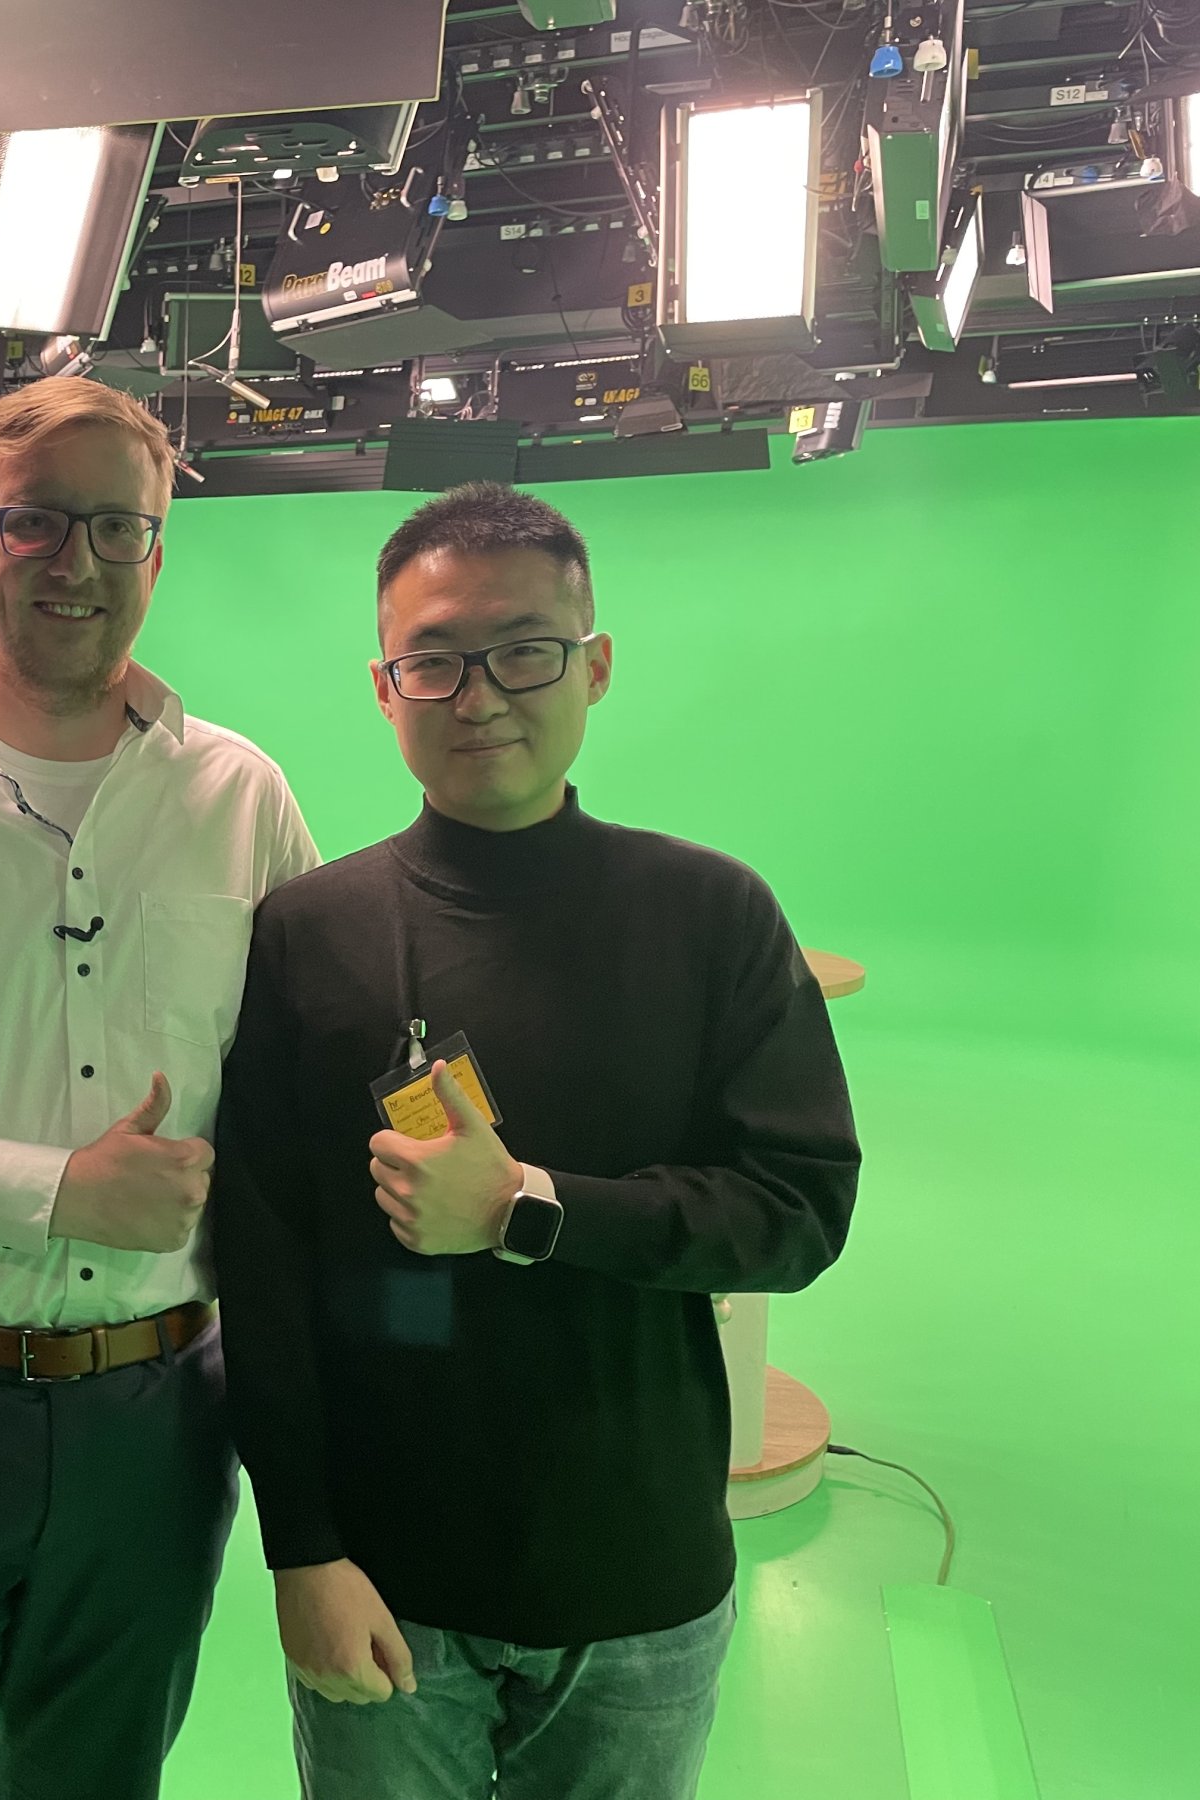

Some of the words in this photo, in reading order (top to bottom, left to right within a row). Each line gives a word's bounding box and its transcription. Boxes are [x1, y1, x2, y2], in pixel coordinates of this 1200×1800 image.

[1056, 88, 1081, 101] S12
[504, 225, 523, 236] S14
[282, 254, 388, 304] ParaBeam
[634, 290, 645, 303] 3
[691, 373, 710, 389] 66
[288, 406, 304, 420] 47
